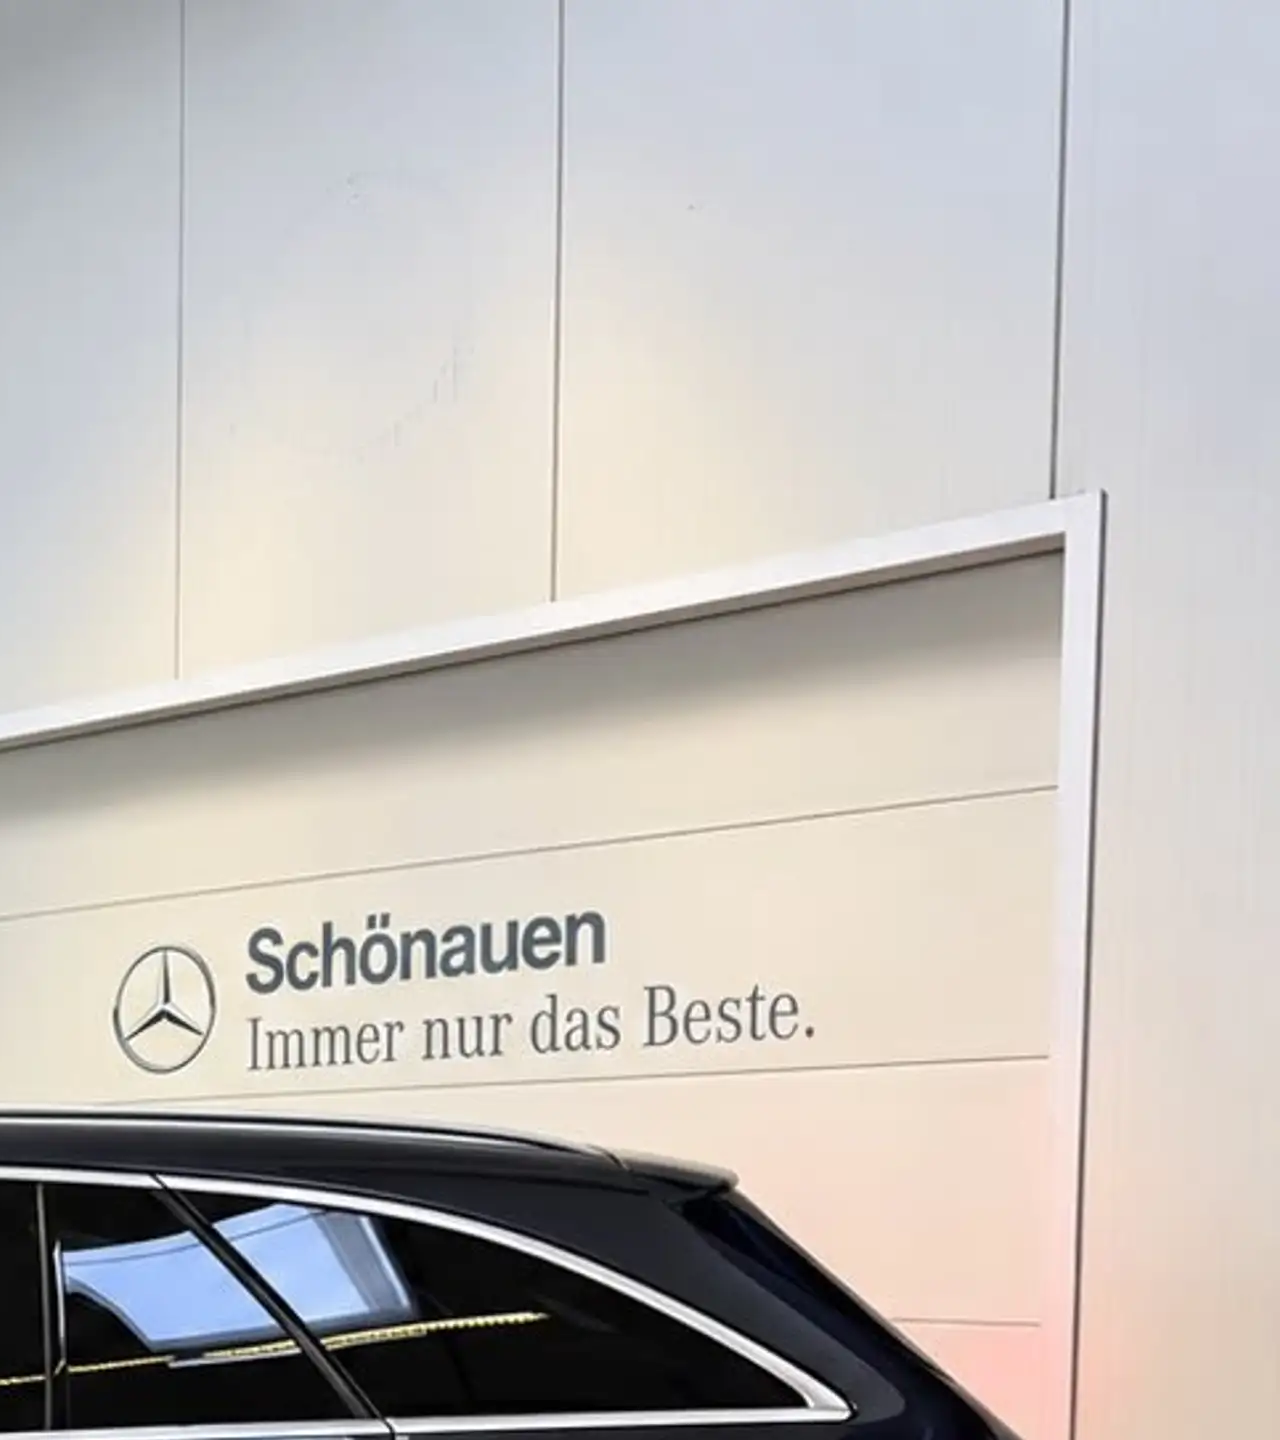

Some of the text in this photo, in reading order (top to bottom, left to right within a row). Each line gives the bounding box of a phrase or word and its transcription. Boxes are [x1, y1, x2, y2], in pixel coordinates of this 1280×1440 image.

[244, 911, 606, 996] Schönauen
[246, 982, 816, 1072] Immer nur das Beste.
